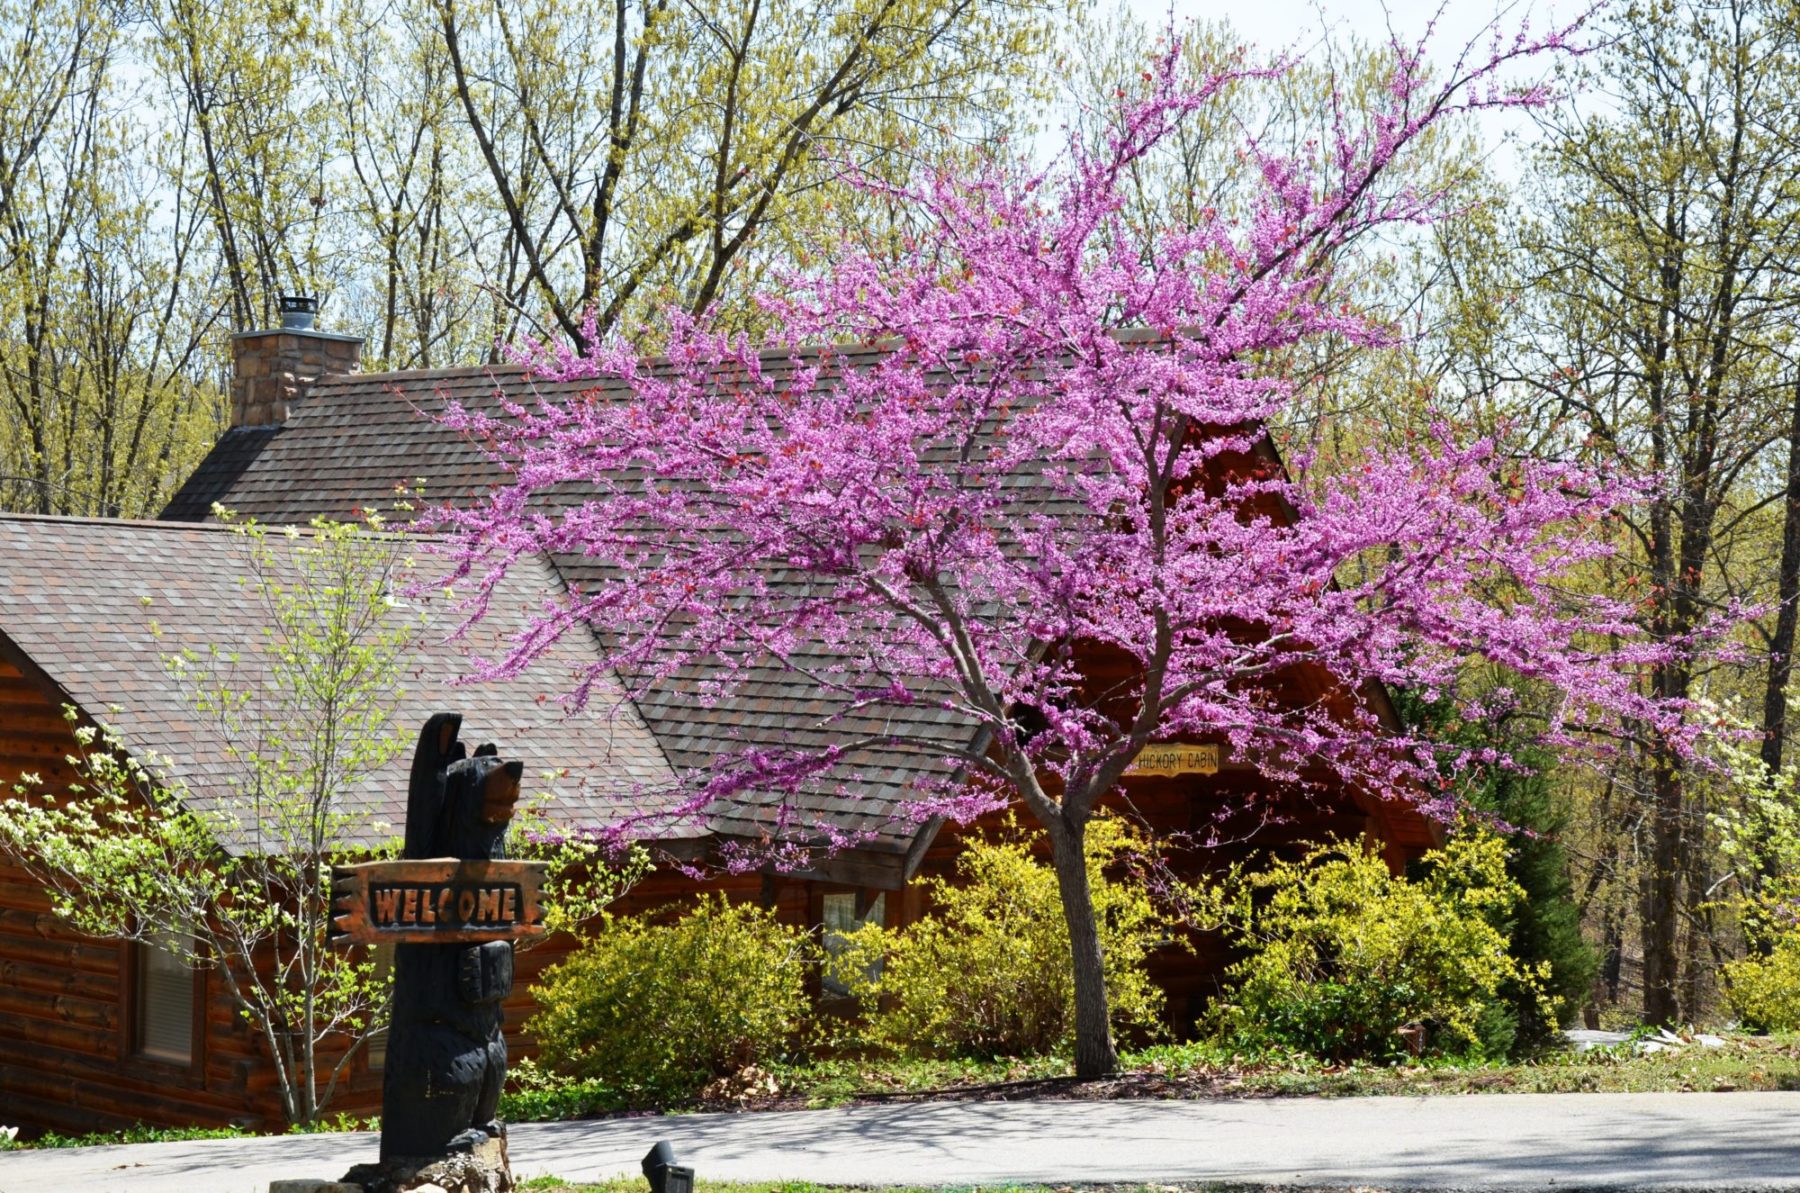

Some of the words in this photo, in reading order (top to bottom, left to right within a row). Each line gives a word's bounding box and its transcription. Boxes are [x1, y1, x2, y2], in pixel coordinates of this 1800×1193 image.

[1138, 753, 1183, 769] HICKORY
[1187, 752, 1217, 768] CABIN
[375, 888, 516, 922] WELCOME
